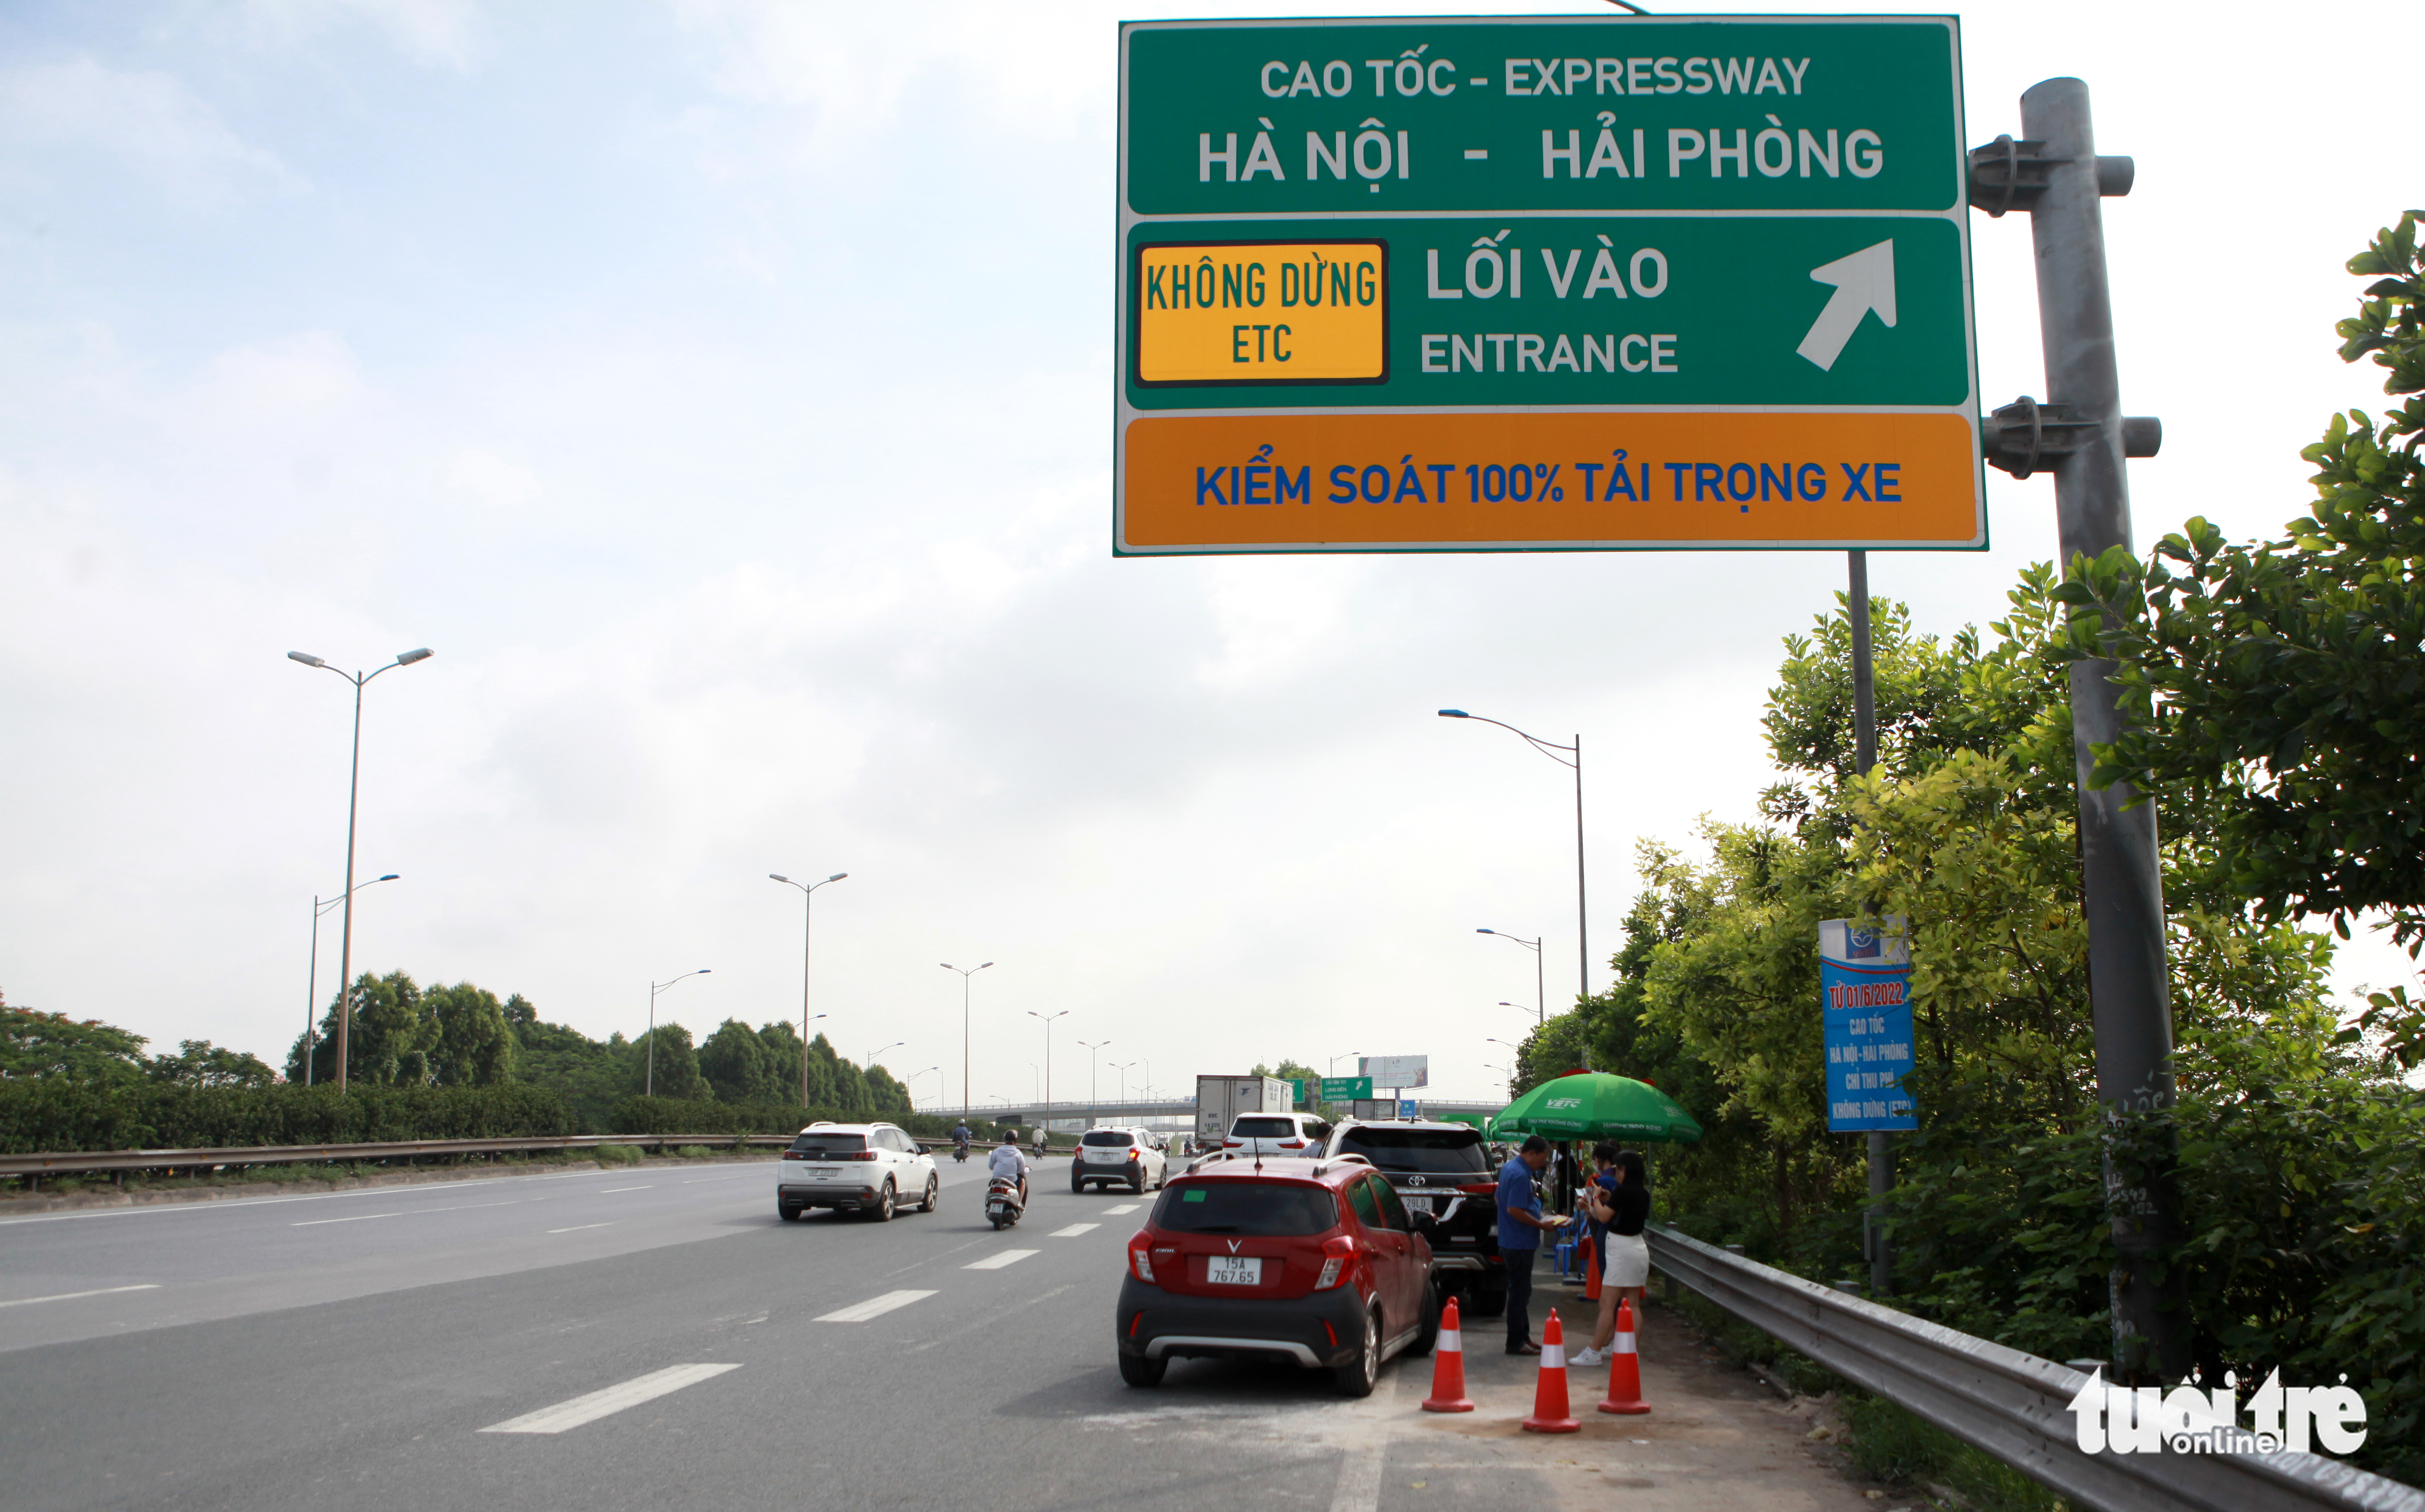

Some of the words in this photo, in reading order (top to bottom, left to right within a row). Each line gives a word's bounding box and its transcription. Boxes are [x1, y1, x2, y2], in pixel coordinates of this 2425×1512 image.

[1261, 60, 1352, 97] CAO
[1366, 44, 1456, 97] TỐC
[1505, 57, 1811, 96] EXPRESSWAY
[1199, 117, 1285, 182] HÀ
[1306, 117, 1409, 193] NỘI
[1464, 150, 1488, 159] -
[1542, 111, 1645, 178] HẢI
[1668, 114, 1884, 178] PHÒNG
[1426, 228, 1521, 300] LỐI
[1541, 234, 1668, 299] VÀO
[1146, 254, 1266, 310] KHÔNG
[1280, 252, 1377, 307] DỪNG
[1232, 323, 1293, 363] ETC
[1421, 333, 1678, 373] ENTRANCE
[1194, 444, 1311, 506] KIỂM
[1328, 454, 1456, 504] SOÁT
[1465, 463, 1564, 504] 100%
[1575, 448, 1649, 503] TẢI
[1664, 462, 1826, 514] TRỌNG
[1840, 463, 1902, 503] XE
[1829, 980, 1845, 1009] TỪ
[1846, 981, 1903, 1008] 01/6/2022
[1850, 1018, 1867, 1035] CAO
[1868, 1011, 1885, 1034] TỐC
[1830, 1043, 1842, 1063] HÀ
[1843, 1043, 1858, 1066] NỘI
[1862, 1038, 1877, 1062] HẢI
[1879, 1039, 1909, 1061] PHÒNG
[1845, 1067, 1860, 1090] CHỈ
[1861, 1072, 1878, 1089] THU
[1880, 1068, 1894, 1088] PHÍ
[1546, 1099, 1581, 1108] VETC
[1832, 1099, 1862, 1119] KHÔNG
[1862, 1097, 1887, 1118] DỪNG
[1406, 1199, 1426, 1208] 29LD
[1213, 1270, 1254, 1283] 767.65
[1225, 1258, 1245, 1270] 15A
